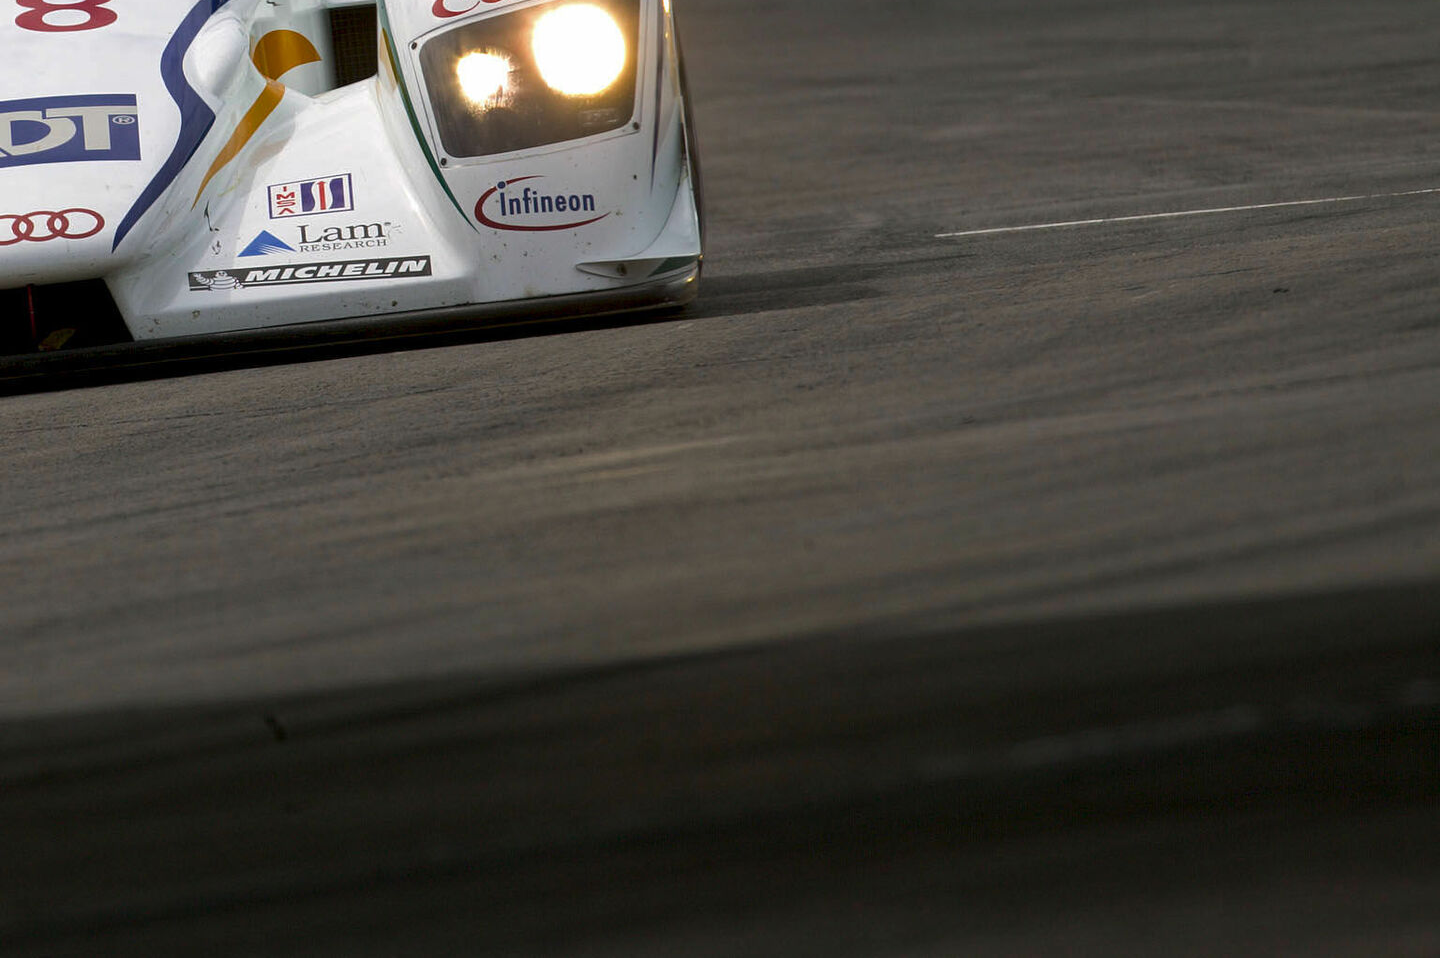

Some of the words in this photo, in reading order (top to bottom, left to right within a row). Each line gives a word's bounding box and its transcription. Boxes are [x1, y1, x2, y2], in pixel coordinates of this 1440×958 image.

[297, 222, 386, 244] Lam
[300, 239, 387, 253] RESEARCH
[245, 259, 427, 282] MICHELIN
